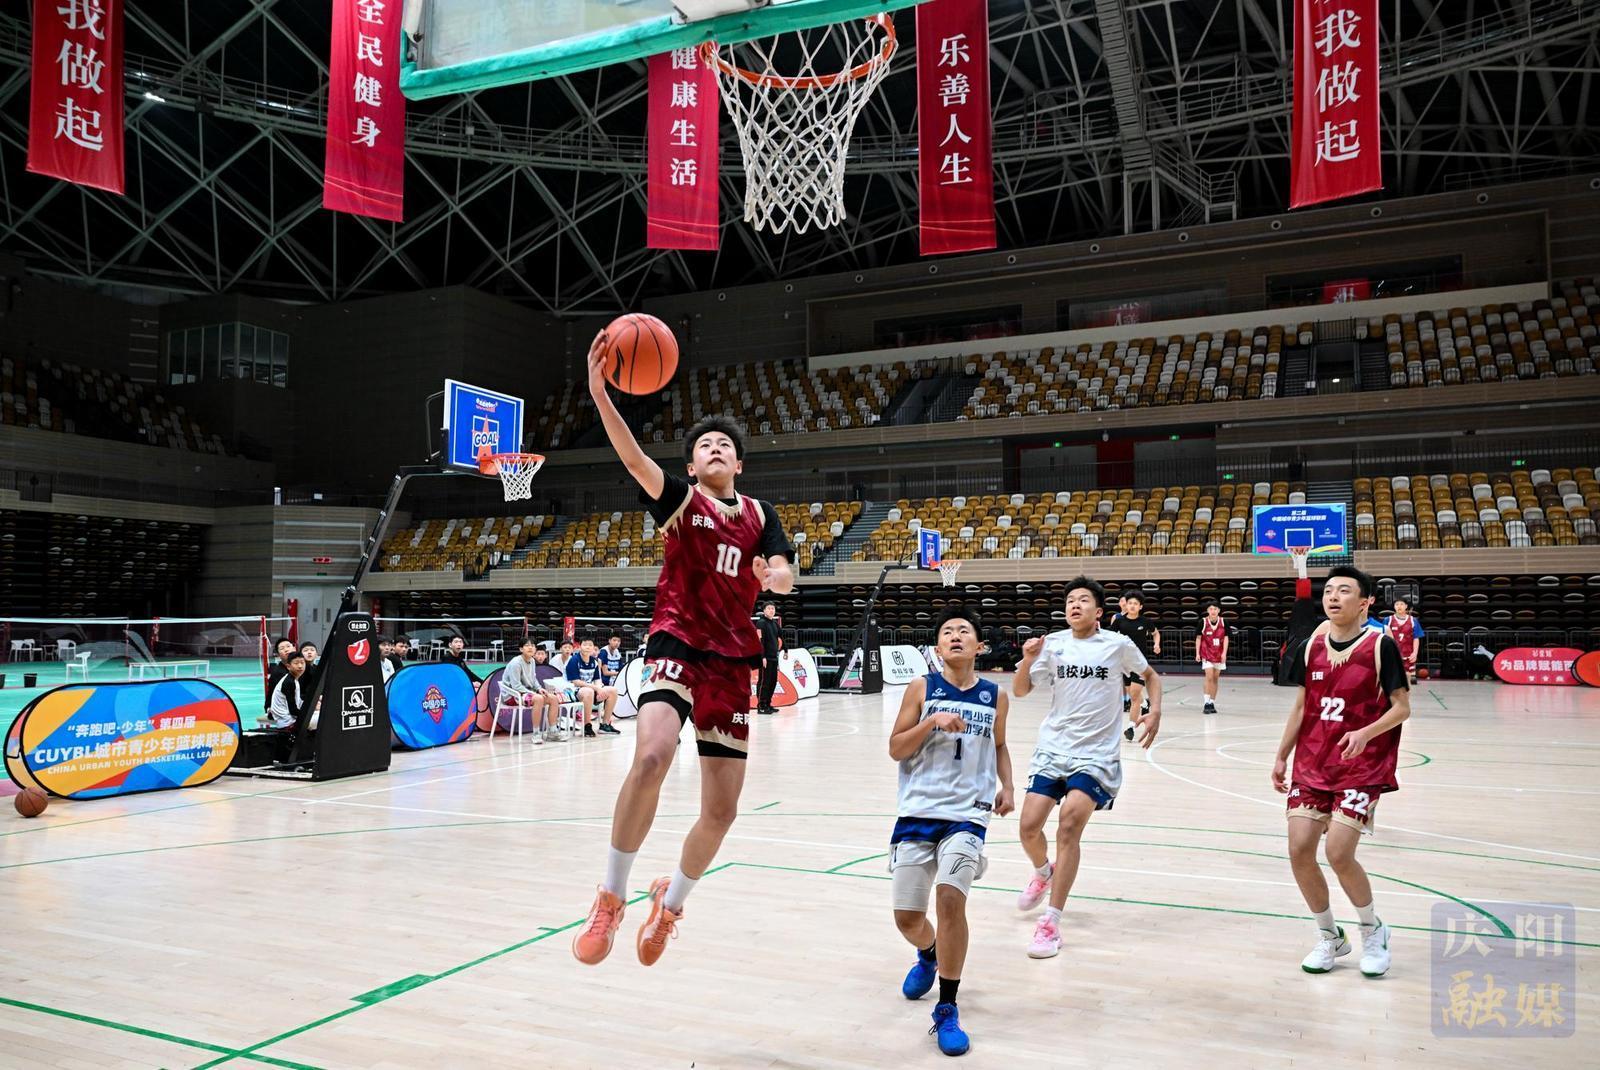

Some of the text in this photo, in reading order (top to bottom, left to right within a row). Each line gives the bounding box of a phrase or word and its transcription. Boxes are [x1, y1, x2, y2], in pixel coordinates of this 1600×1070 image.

[54, 0, 106, 152] 我做起
[352, 0, 384, 148] 全民健身
[1314, 0, 1363, 168] 我做起
[670, 46, 697, 187] 健康生活
[938, 33, 973, 186] 乐善人生
[474, 431, 498, 447] GOAL
[692, 513, 715, 530] 庆阳
[716, 543, 743, 578] 10
[159, 715, 197, 731] 第四届
[1320, 696, 1346, 722] 22
[47, 749, 226, 775] CHINA URBAN YOUTH BASKETBALL LEAGUE
[954, 737, 962, 760] 1
[1339, 788, 1370, 816] 22
